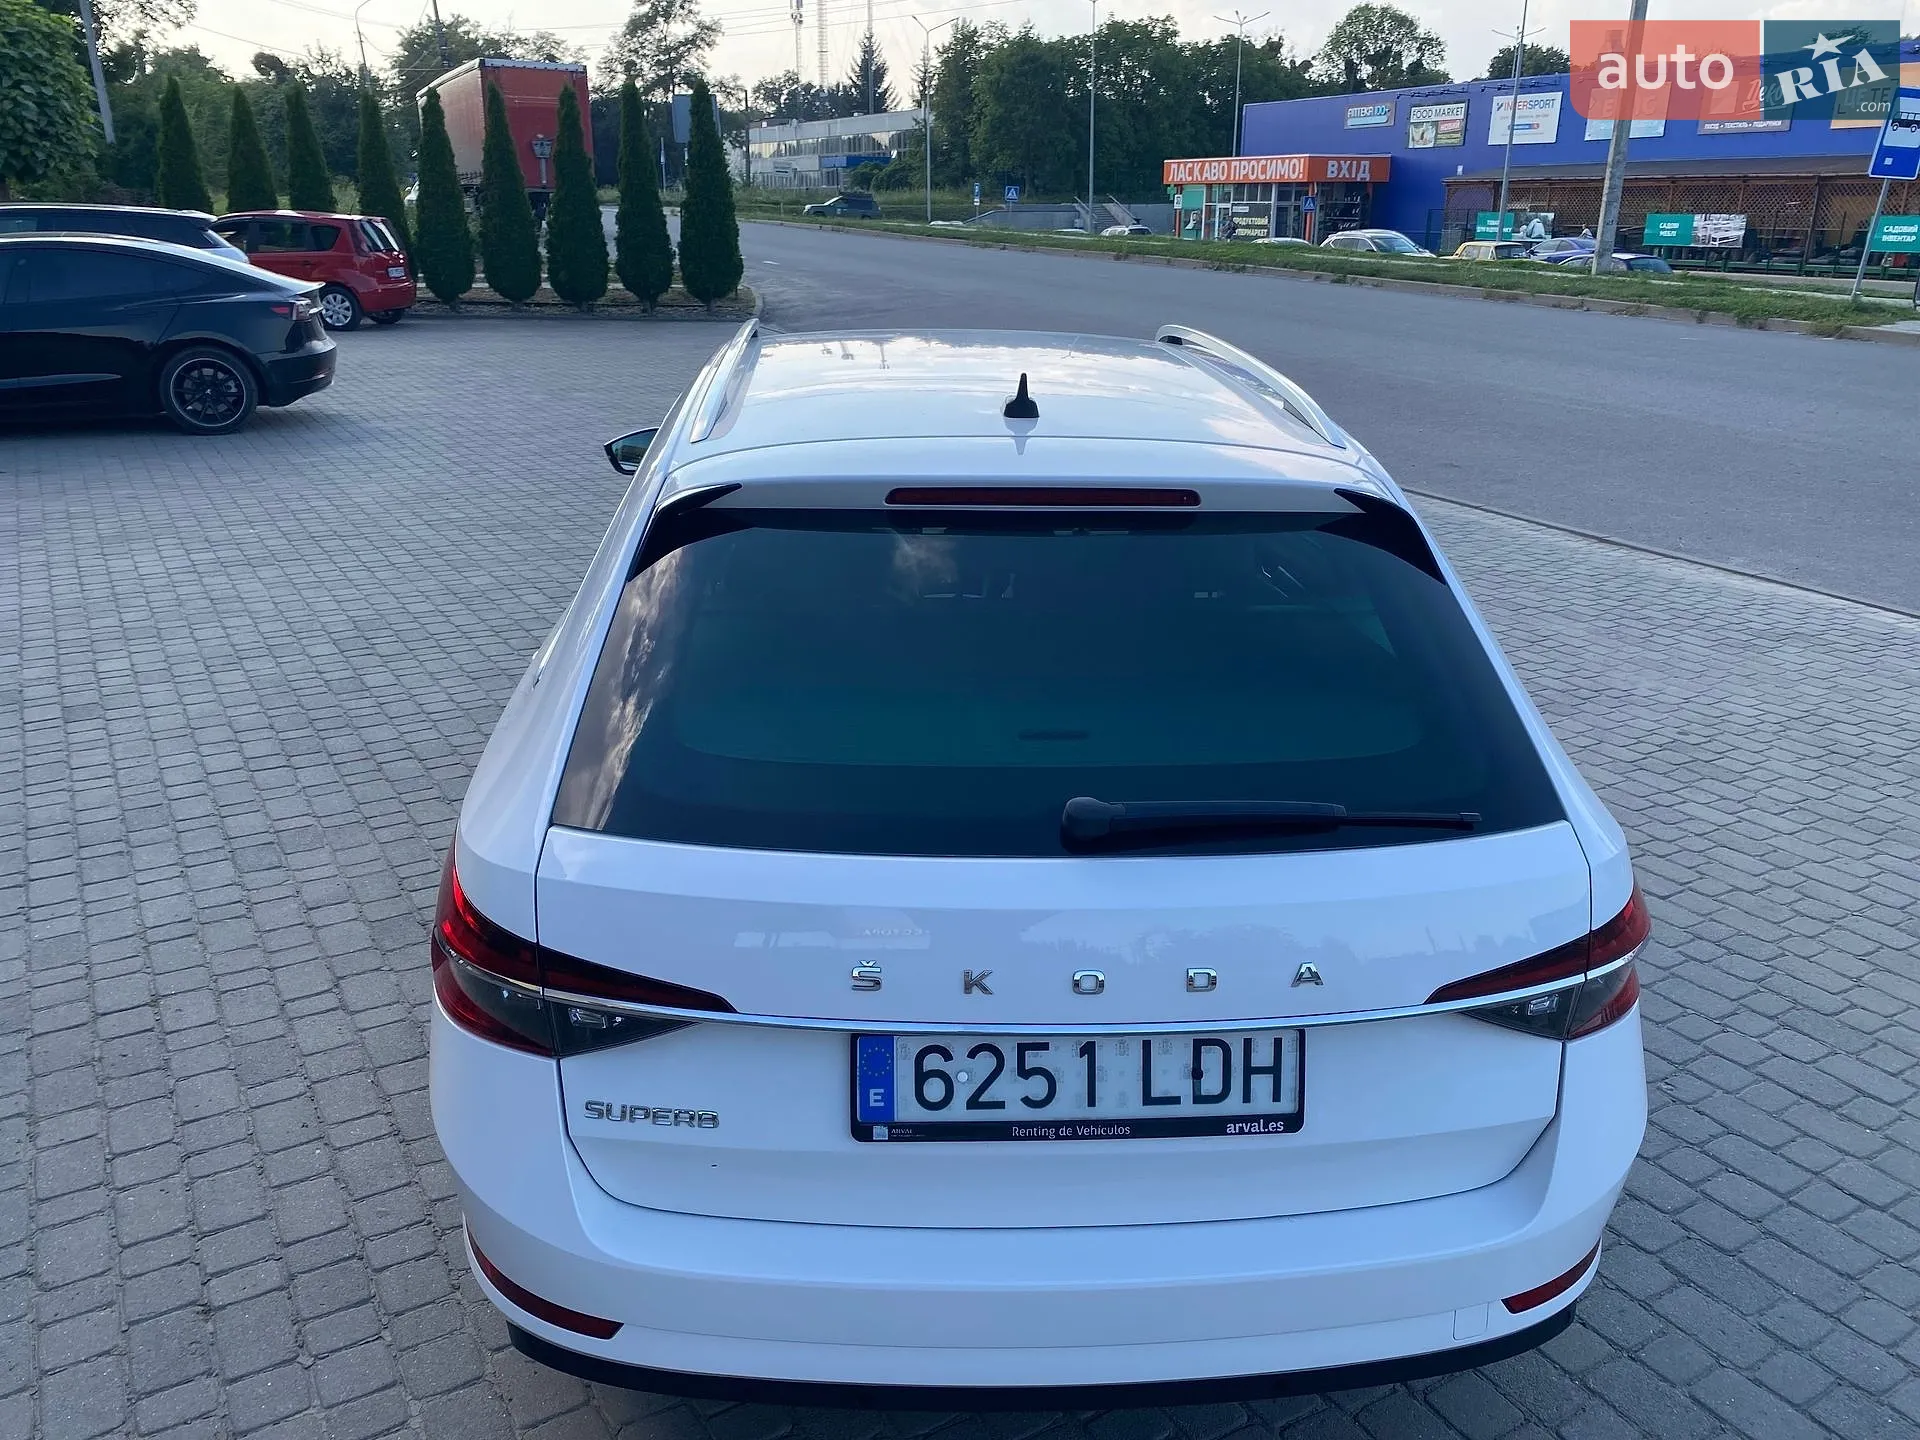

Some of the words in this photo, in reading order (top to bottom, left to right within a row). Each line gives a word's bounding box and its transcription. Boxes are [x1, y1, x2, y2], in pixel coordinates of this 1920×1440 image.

[1412, 109, 1433, 119] FOOD
[1434, 106, 1464, 117] MARKET
[1503, 98, 1556, 111] INERSPORT
[1168, 160, 1226, 182] ЛАСКАВО
[1230, 158, 1304, 182] ПРОСИМО!
[1327, 160, 1371, 182] ВХІД
[913, 1039, 1097, 1112] 6251
[1141, 1036, 1283, 1107] LDH
[868, 1088, 885, 1107] E
[584, 1099, 720, 1129] SUPERB
[1012, 1126, 1056, 1140] Renting
[1058, 1125, 1073, 1137] de
[1226, 1118, 1285, 1134] arval.es
